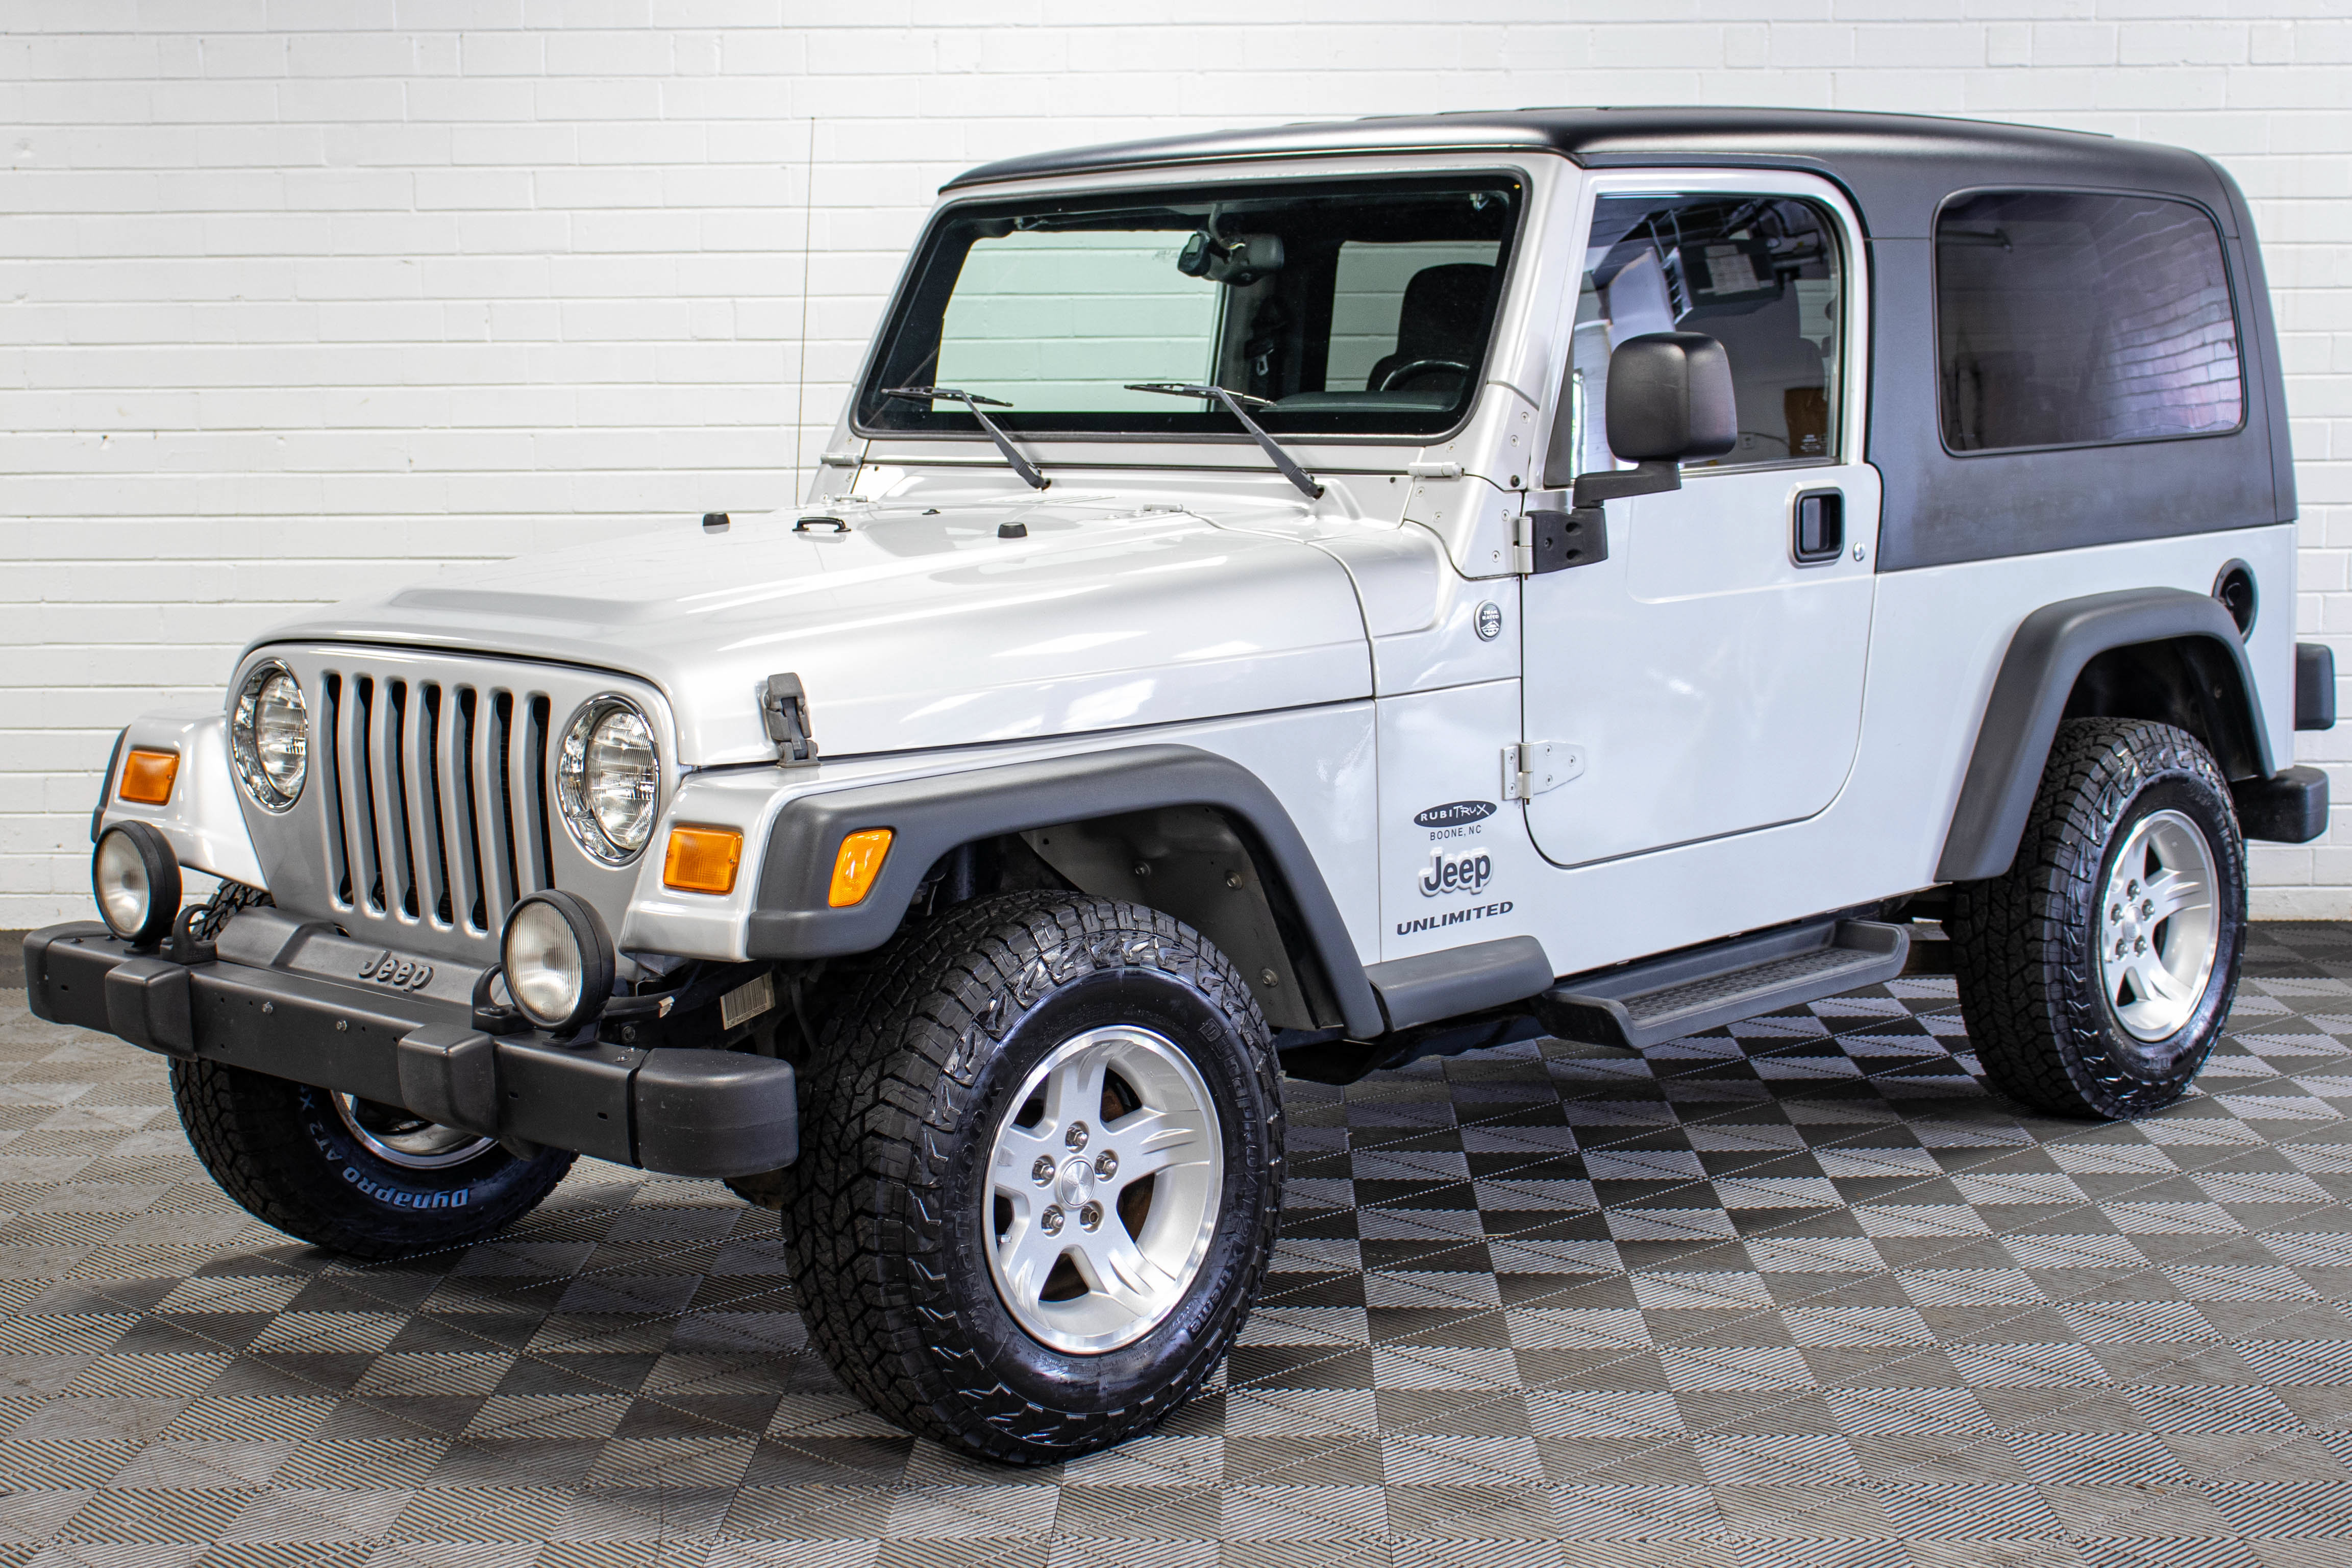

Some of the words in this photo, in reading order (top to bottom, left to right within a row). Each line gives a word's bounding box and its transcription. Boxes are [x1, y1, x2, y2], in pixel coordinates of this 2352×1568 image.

[1430, 827, 1466, 841] BOONE,
[1469, 825, 1482, 835] NC
[1423, 854, 1491, 892] Jeep
[1396, 901, 1514, 936] UNLIMITED
[358, 950, 434, 993] Jeep
